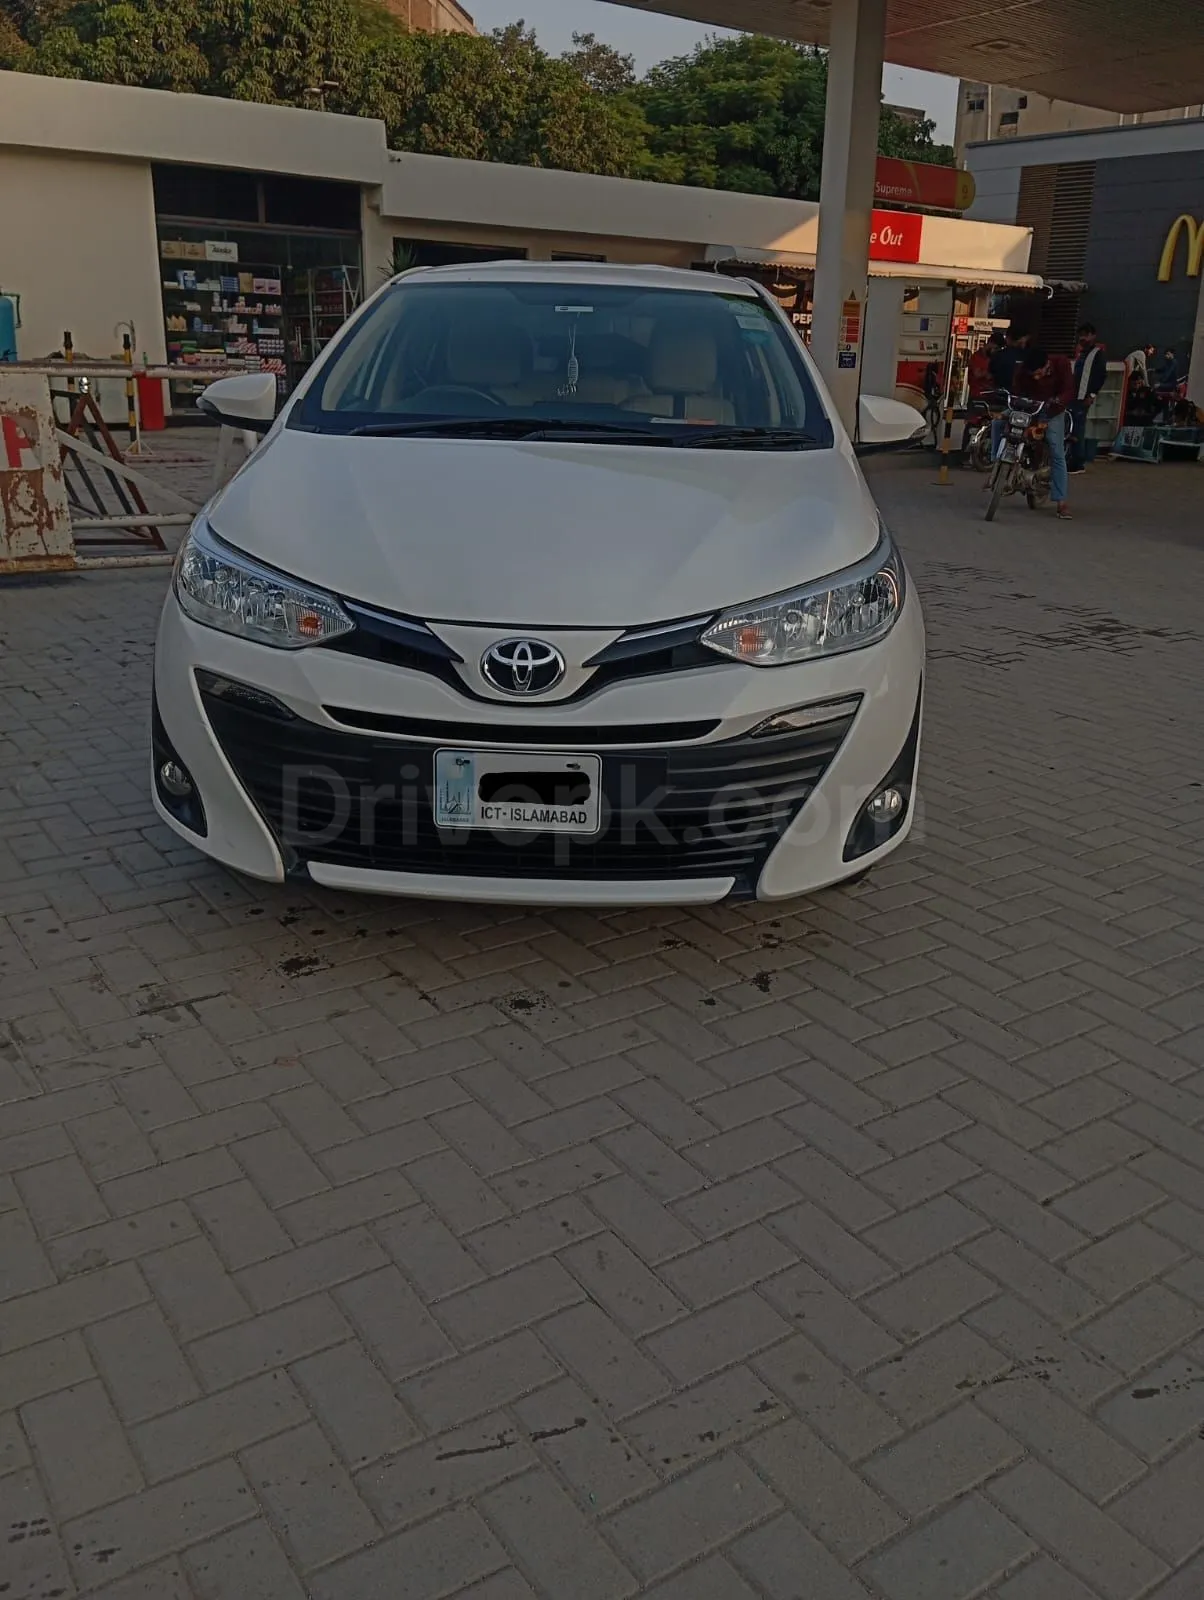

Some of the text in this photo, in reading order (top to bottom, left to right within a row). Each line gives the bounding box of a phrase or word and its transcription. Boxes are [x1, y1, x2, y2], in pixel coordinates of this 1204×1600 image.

[875, 181, 913, 197] Supreme
[879, 225, 903, 246] Out
[510, 808, 588, 824] ISLAMABAD
